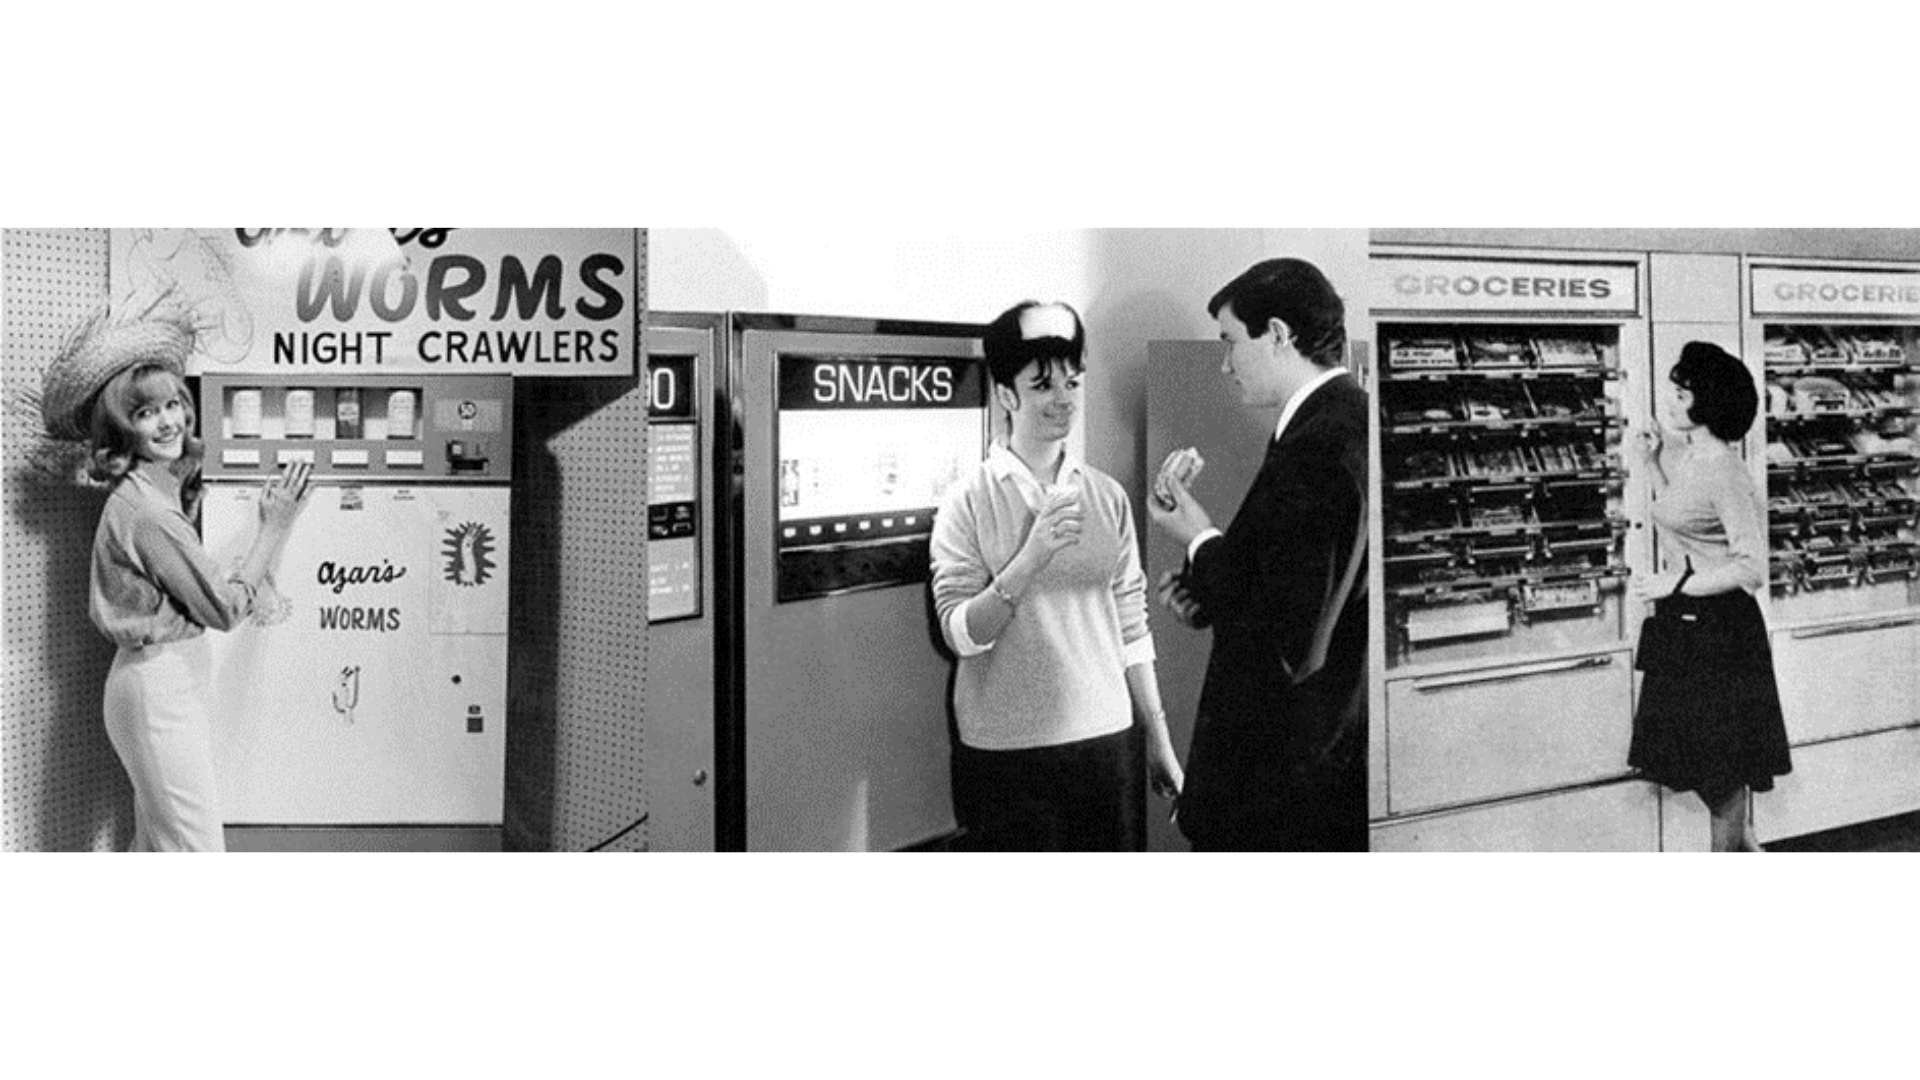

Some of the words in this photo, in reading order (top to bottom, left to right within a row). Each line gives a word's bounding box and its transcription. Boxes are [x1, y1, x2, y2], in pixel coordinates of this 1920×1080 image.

[296, 252, 626, 323] WORMS
[1393, 274, 1611, 299] GROCERIES
[273, 331, 393, 365] NIGHT
[417, 328, 620, 364] CRAWLERS
[813, 363, 953, 404] SNACKS
[319, 605, 401, 633] WORMS
